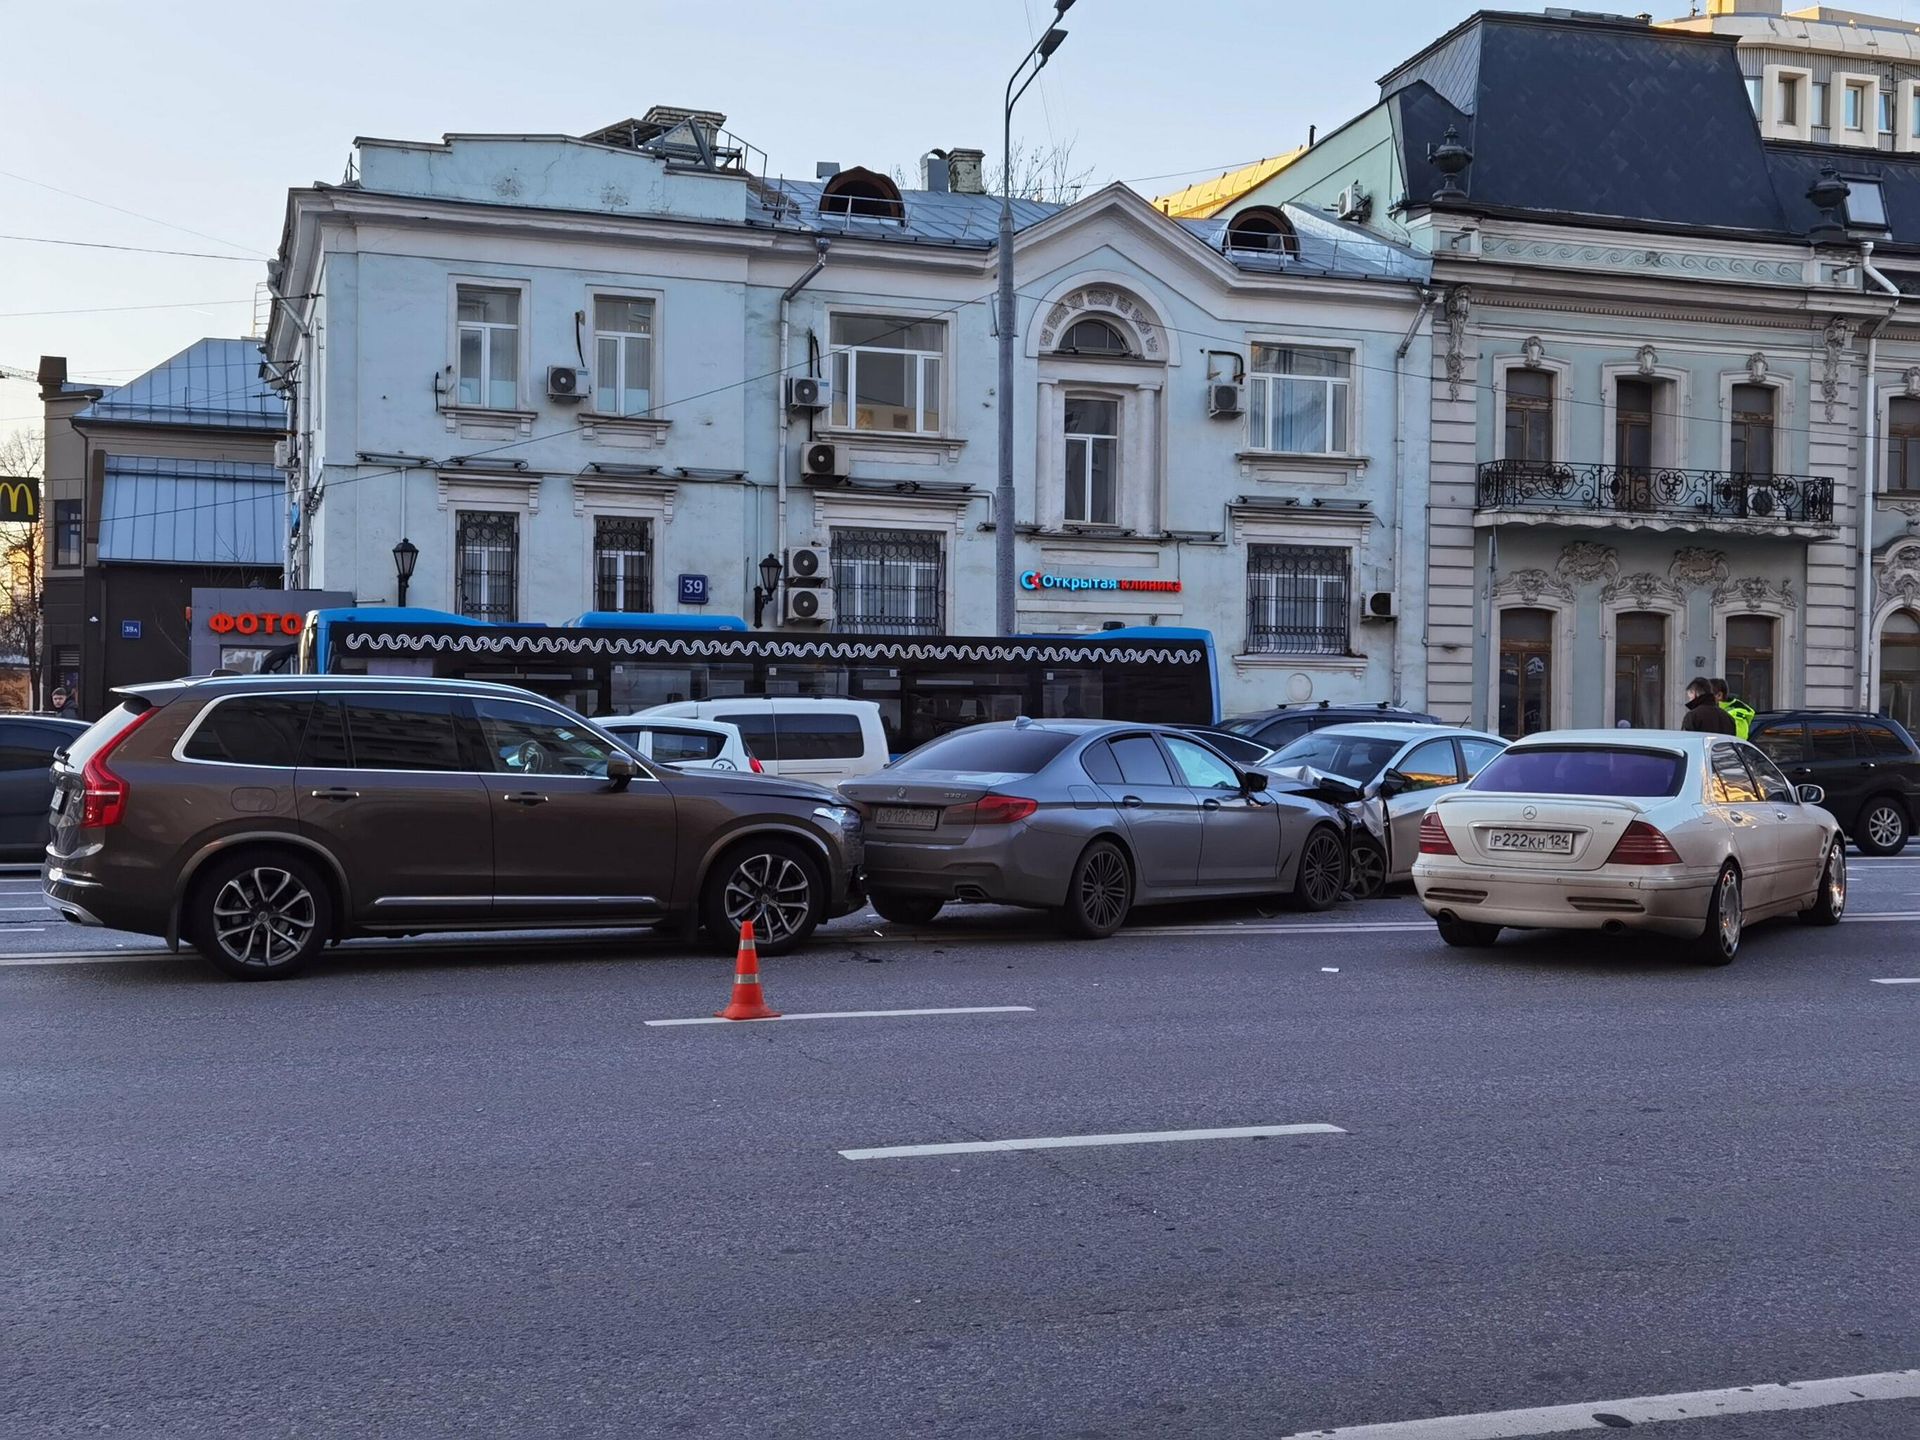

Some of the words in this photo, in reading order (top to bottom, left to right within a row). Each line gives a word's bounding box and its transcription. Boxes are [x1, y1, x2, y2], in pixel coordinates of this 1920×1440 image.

[684, 579, 703, 594] 39
[1042, 574, 1117, 591] Открытая
[1120, 579, 1183, 592] клиника
[208, 612, 303, 635] ФОТО
[1493, 833, 1546, 848] Р222КН
[1548, 834, 1569, 846] 124
